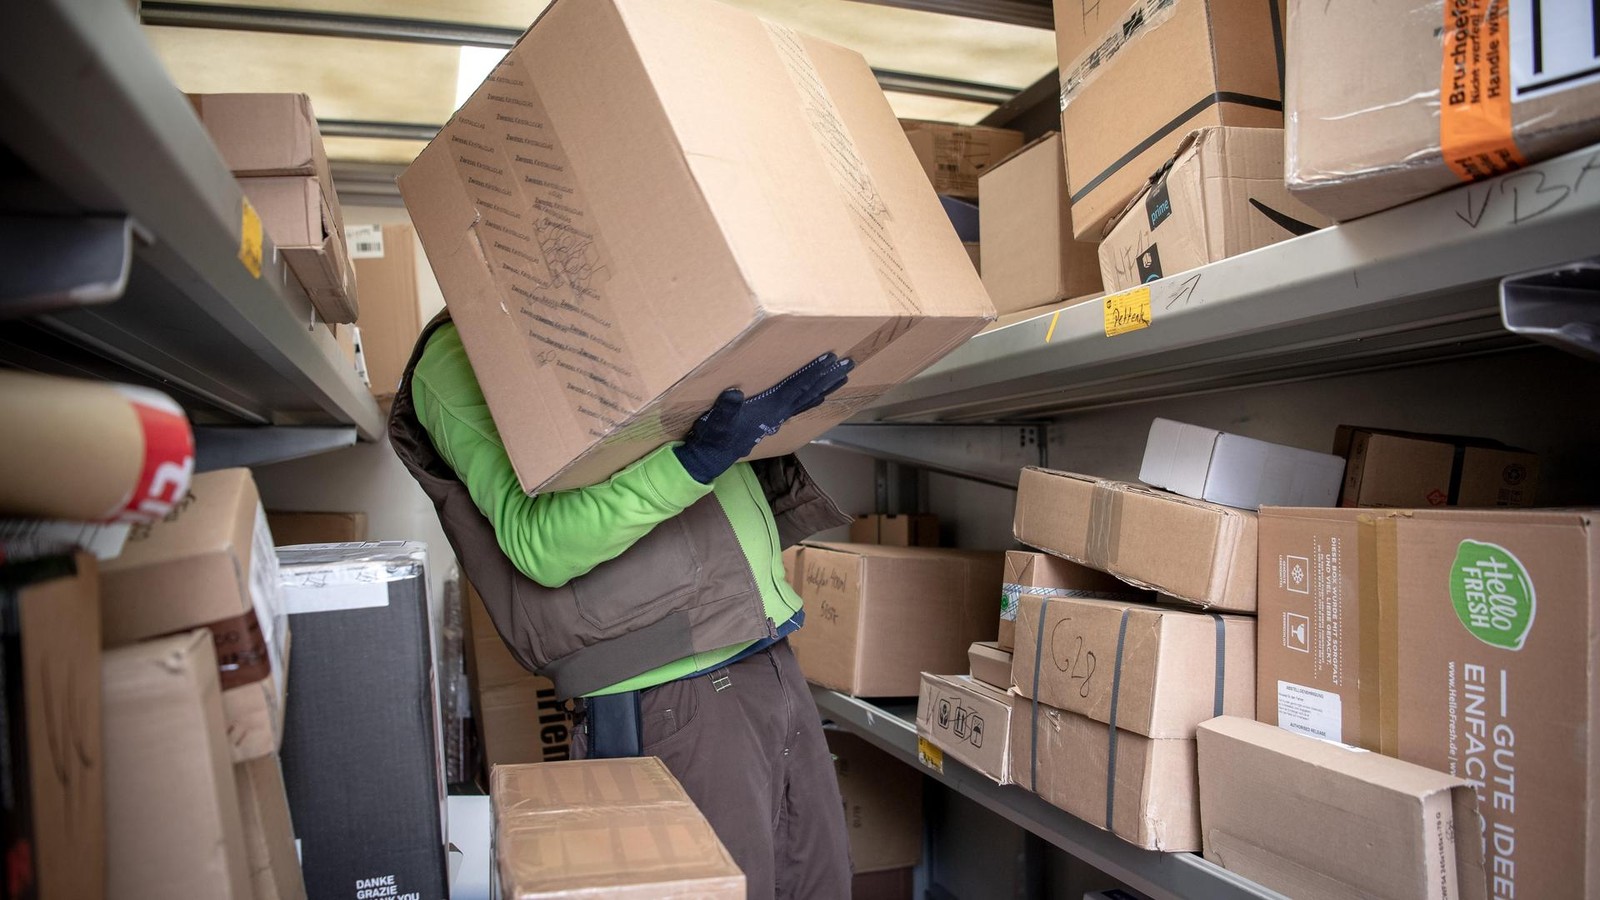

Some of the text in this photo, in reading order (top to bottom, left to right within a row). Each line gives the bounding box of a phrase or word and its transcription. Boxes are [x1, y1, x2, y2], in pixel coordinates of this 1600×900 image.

[1487, 40, 1500, 98] Handle
[1151, 200, 1169, 226] prime
[1462, 567, 1490, 628] FRESH
[1476, 556, 1517, 631] Hello
[1448, 661, 1457, 755] www.HelloFresh.de
[1493, 724, 1515, 900] GUTE IDEE
[356, 875, 395, 890] DANKE
[357, 885, 398, 900] GRAZIE
